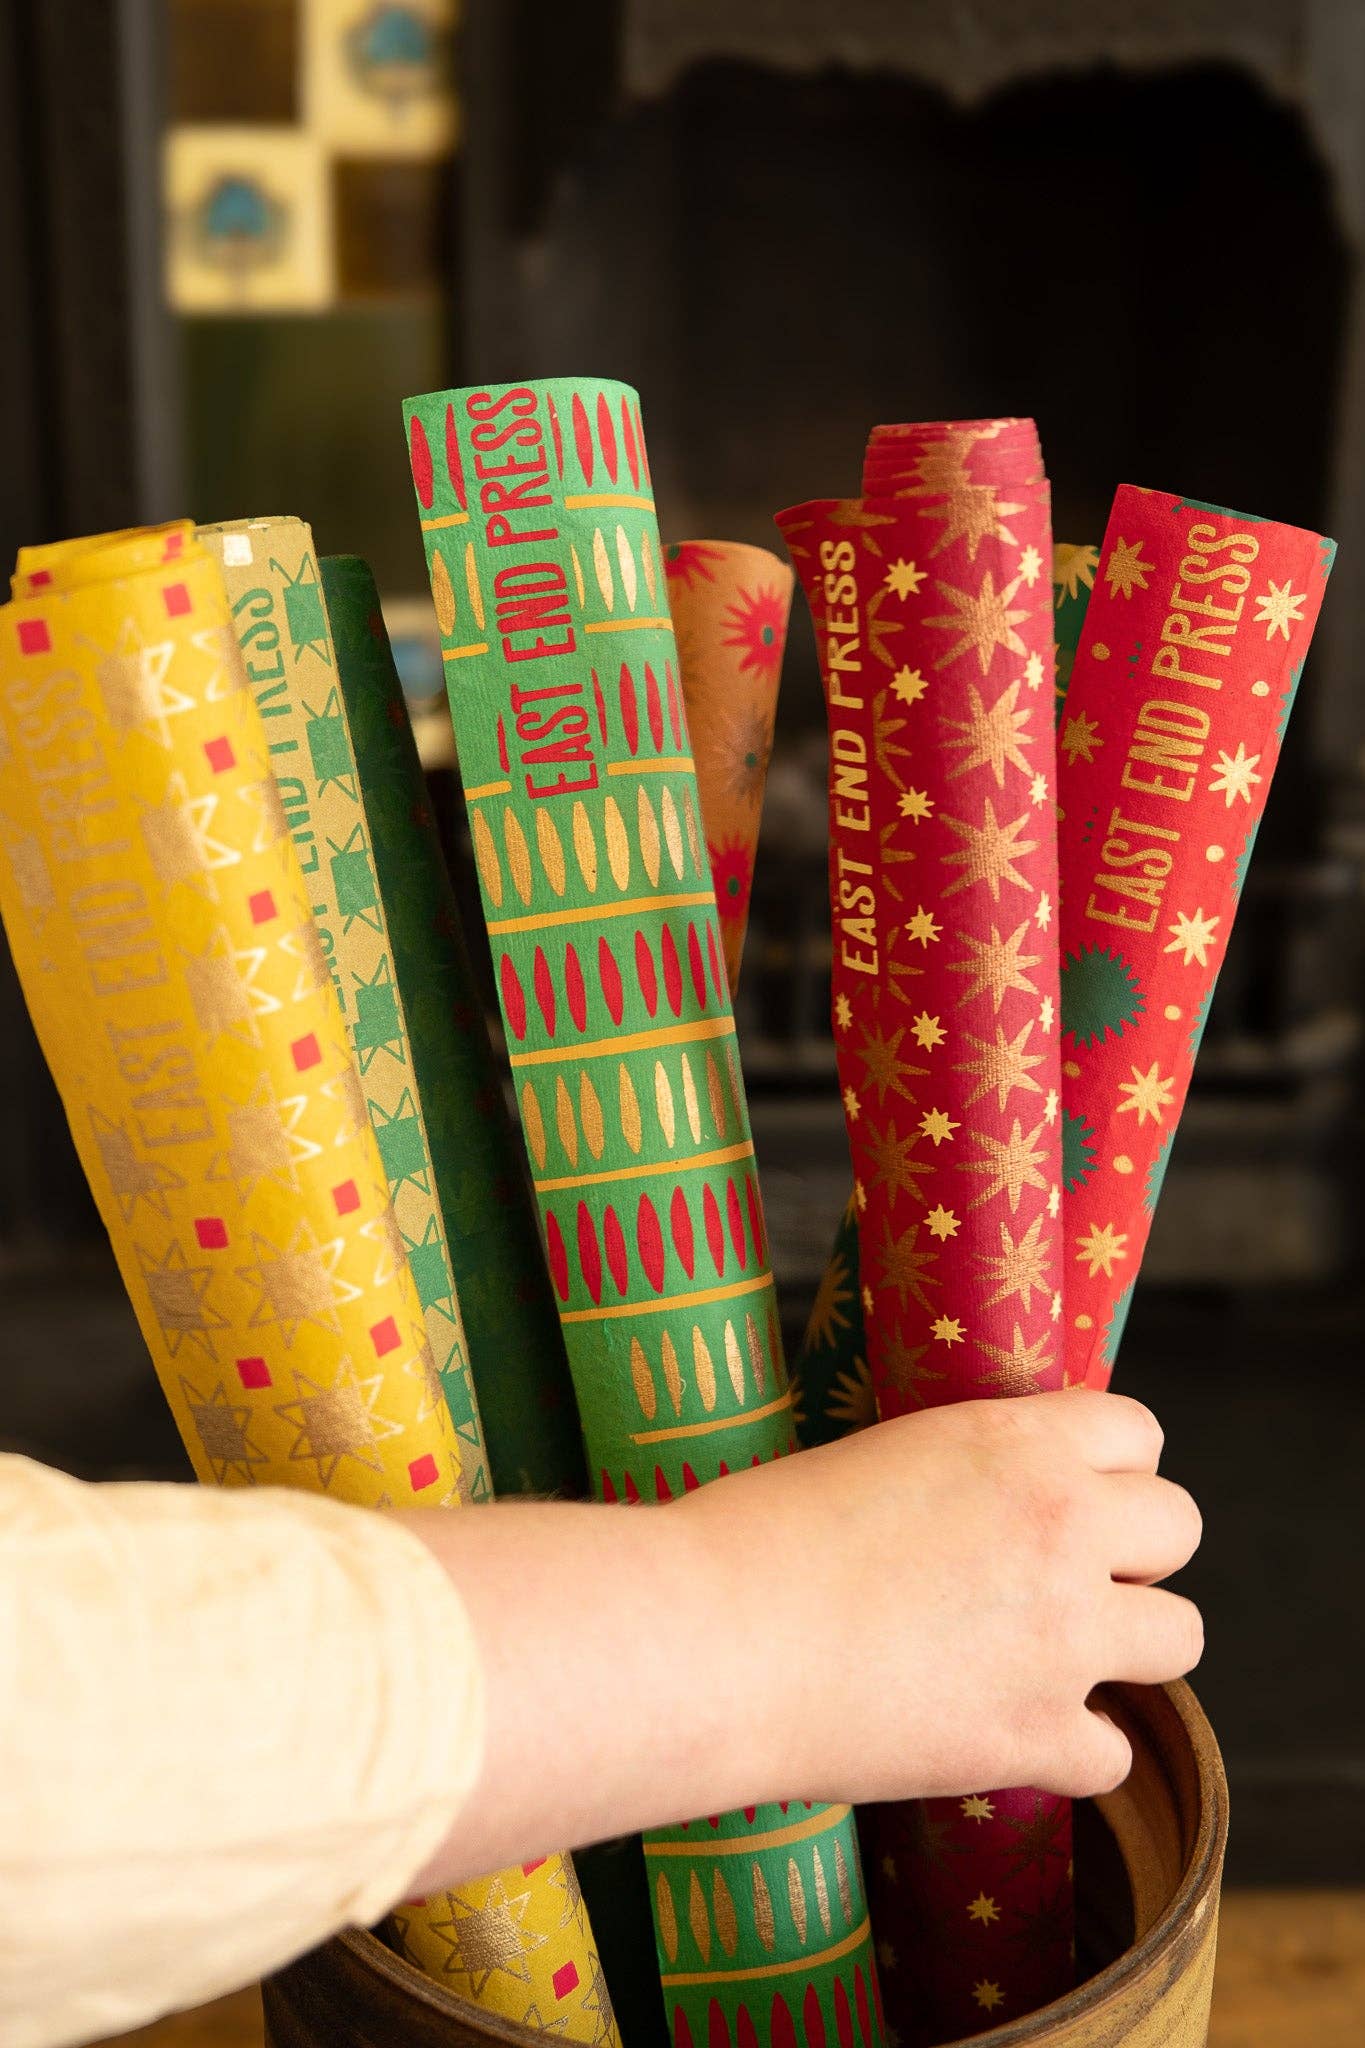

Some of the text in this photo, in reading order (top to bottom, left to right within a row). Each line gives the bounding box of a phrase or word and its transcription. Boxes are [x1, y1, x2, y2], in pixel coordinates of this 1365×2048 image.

[465, 387, 599, 799] EAST END PRESS
[819, 539, 879, 975] EAST END PRESS
[1085, 523, 1261, 933] EAST END PRESS
[5, 667, 216, 1148] EAST END PRESS
